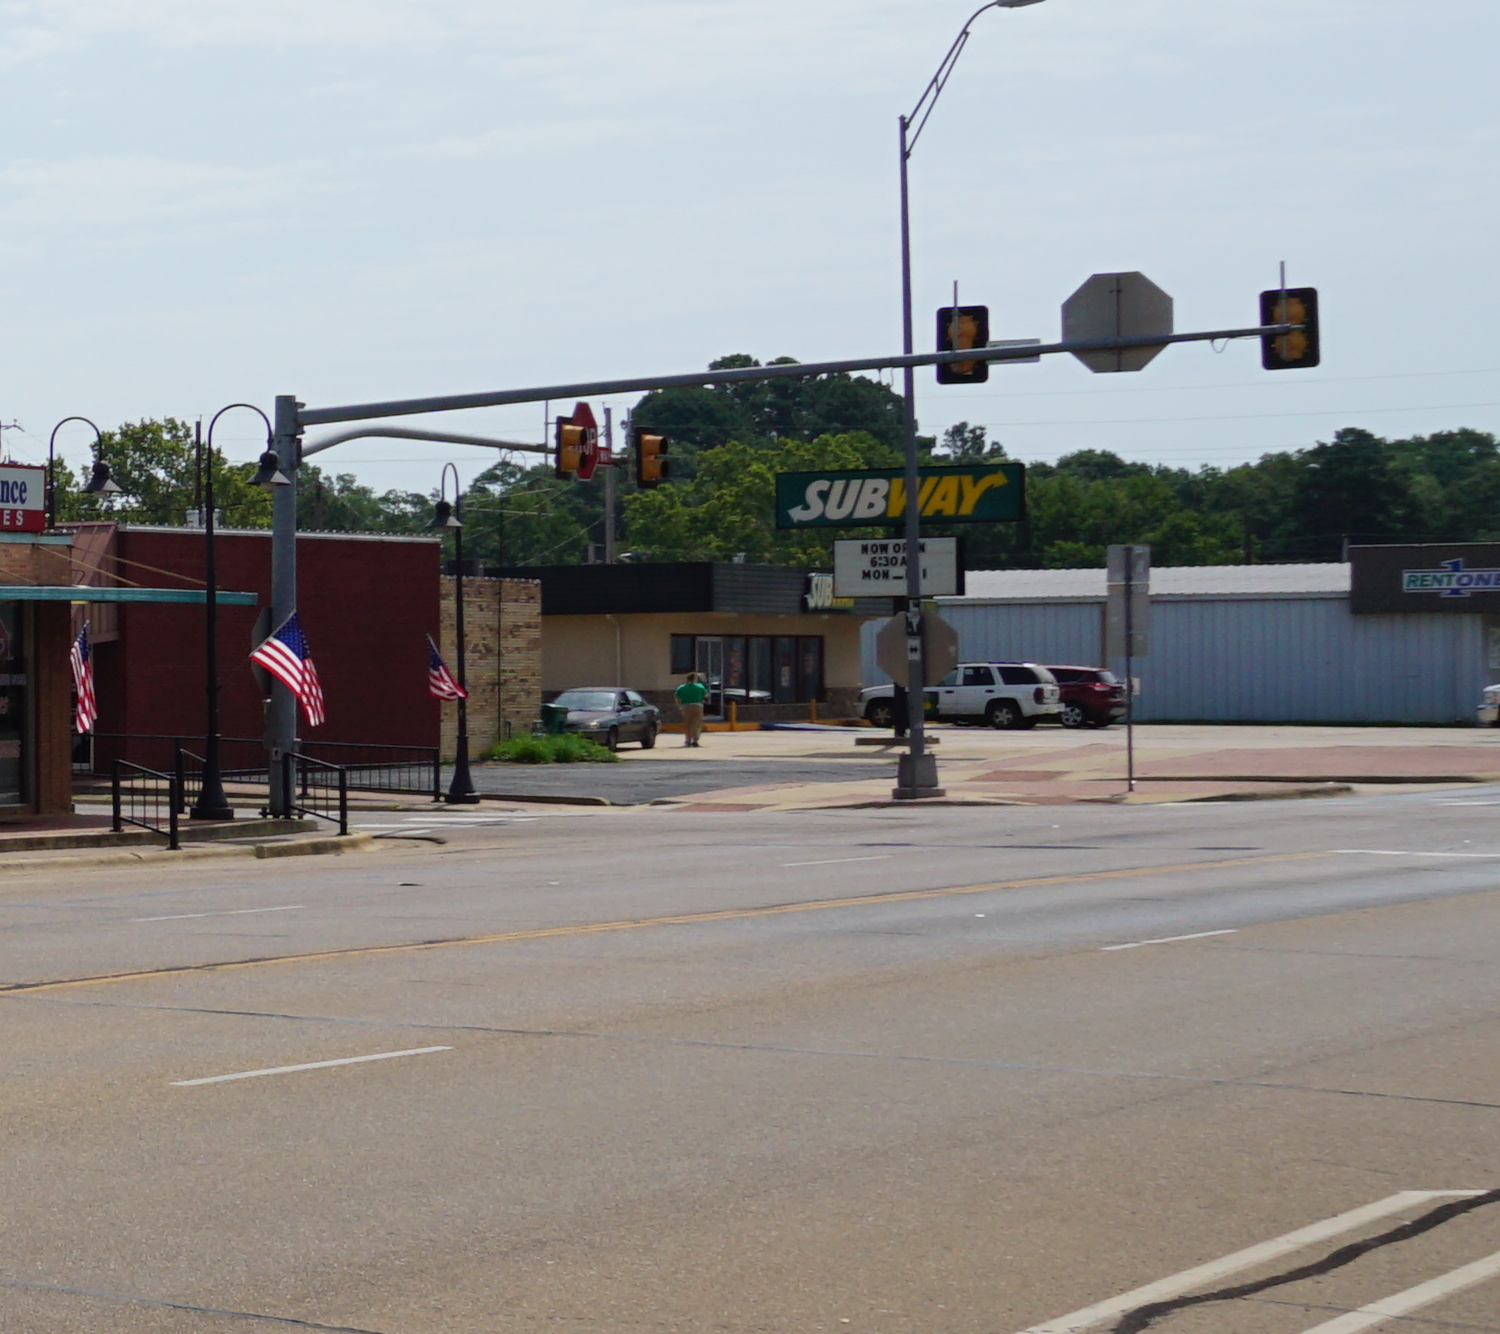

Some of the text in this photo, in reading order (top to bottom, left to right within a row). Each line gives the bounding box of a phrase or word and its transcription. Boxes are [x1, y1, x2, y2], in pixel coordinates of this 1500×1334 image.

[788, 470, 1009, 523] SUBWAY
[861, 543, 889, 554] NOW
[870, 556, 898, 567] 6:30
[862, 569, 890, 580] MON
[1406, 574, 1457, 587] RENT
